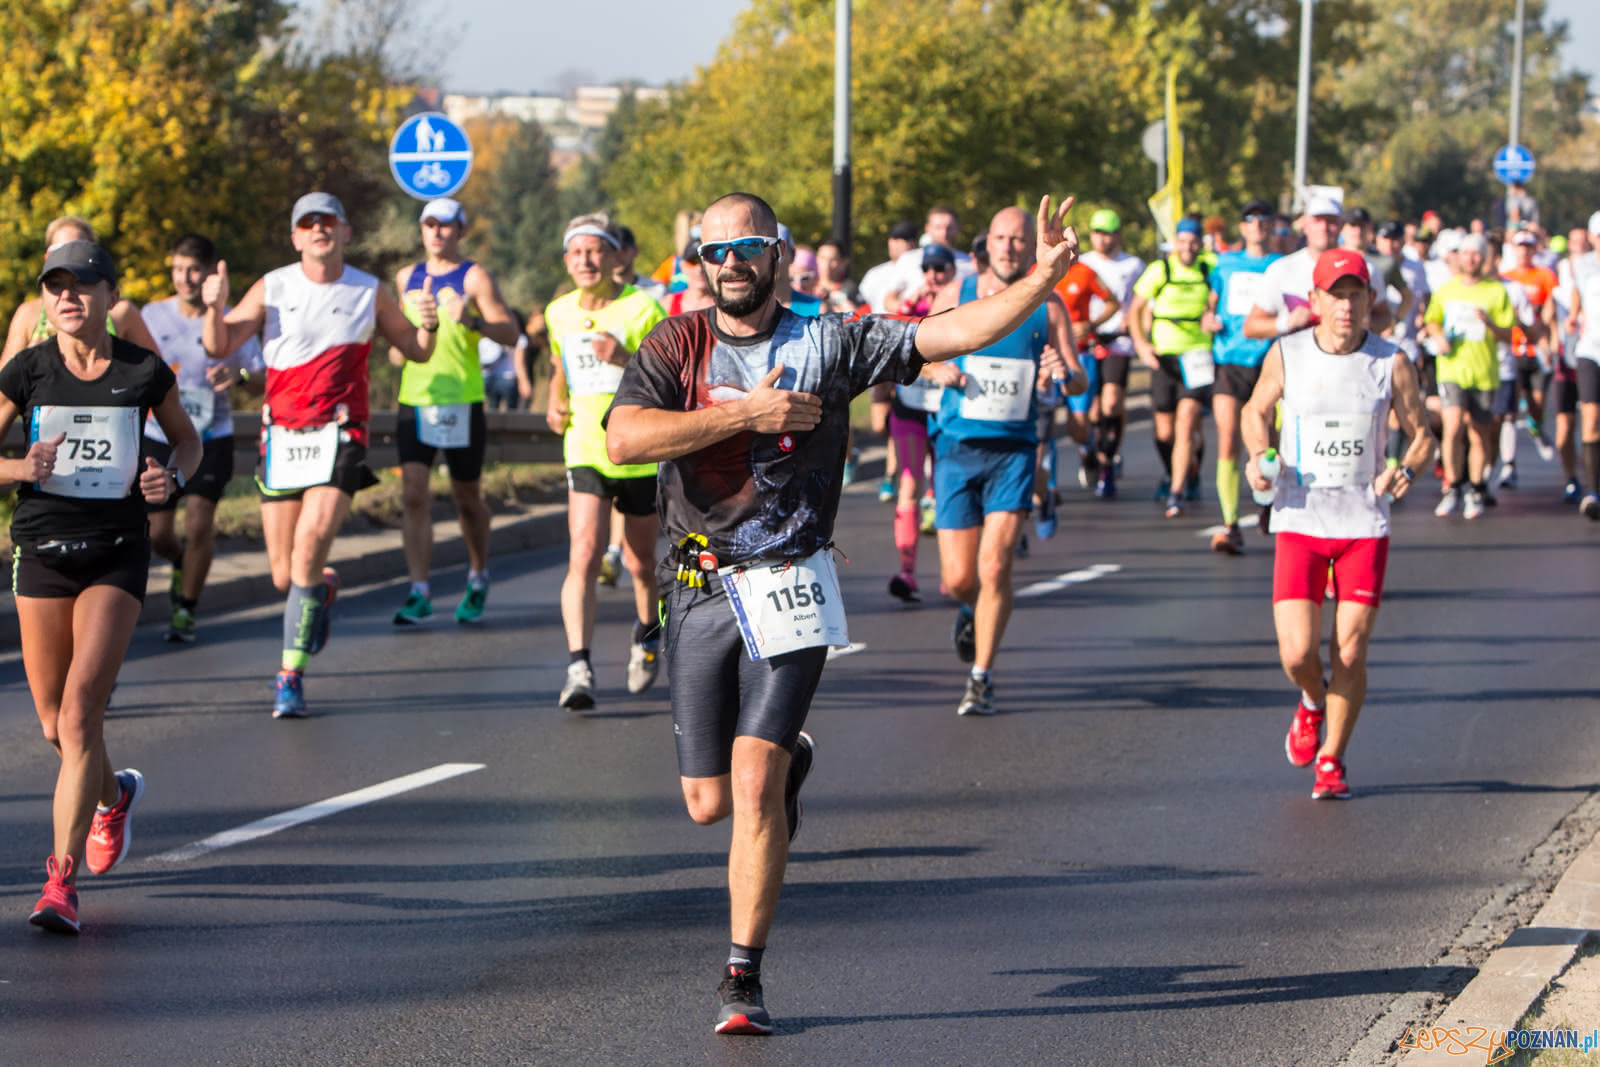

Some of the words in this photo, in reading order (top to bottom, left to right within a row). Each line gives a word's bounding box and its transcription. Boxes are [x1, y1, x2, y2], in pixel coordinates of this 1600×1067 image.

[982, 379, 1019, 396] 3163
[67, 438, 112, 461] 752
[286, 446, 321, 462] 3178
[1313, 440, 1364, 457] 4655
[767, 582, 826, 612] 1158
[793, 612, 817, 622] Albert
